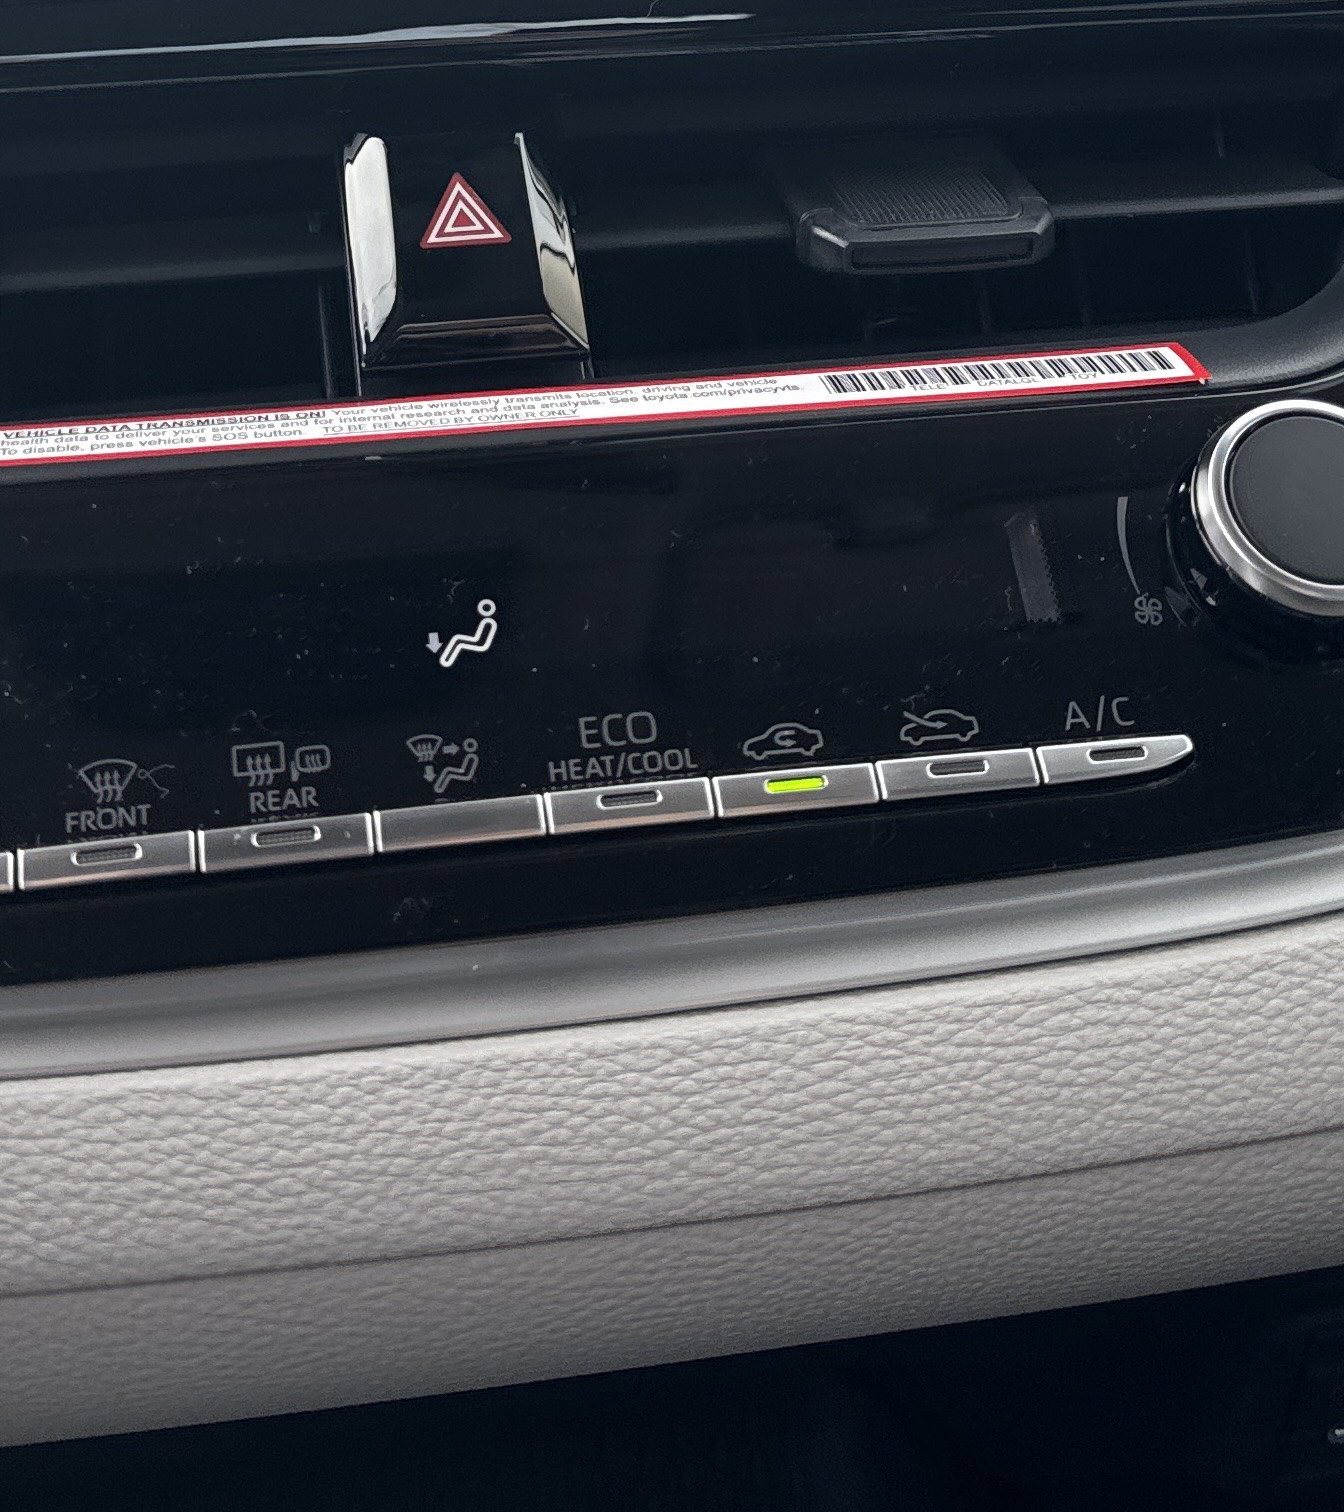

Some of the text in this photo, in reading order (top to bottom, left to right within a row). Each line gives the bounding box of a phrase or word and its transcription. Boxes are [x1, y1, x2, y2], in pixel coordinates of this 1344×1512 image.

[0, 437, 49, 446] health
[54, 435, 89, 443] data
[115, 430, 167, 440] deliver
[172, 426, 206, 437] your
[211, 422, 276, 433] services
[280, 419, 309, 428] and
[314, 417, 334, 425] for
[339, 412, 395, 423] internal
[400, 408, 466, 419] research
[470, 405, 499, 414] and
[503, 403, 536, 412] data
[609, 396, 639, 404] See
[3, 427, 79, 438] VEHICLE
[85, 424, 131, 434] DATA
[137, 414, 269, 429] TRANSMISSION
[332, 408, 366, 417] Your
[370, 403, 424, 413] vehicle
[427, 398, 500, 409] wirelessly
[504, 393, 573, 404] transmits
[642, 384, 691, 394] driving
[695, 382, 723, 390] and
[726, 378, 778, 387] vehicle
[0, 447, 18, 456] To
[90, 441, 134, 451] press
[212, 432, 249, 442] SOS
[323, 425, 344, 434] TO
[347, 423, 368, 431] BE
[373, 418, 451, 430] REMOVED
[454, 415, 474, 423] BY
[478, 410, 537, 422] OWNER
[539, 408, 579, 418] ONLY
[577, 710, 658, 749] ECO
[1064, 695, 1136, 732] A/C
[548, 747, 699, 782] HEAT/COOL
[64, 802, 152, 834] FRONT
[249, 786, 319, 813] REAR
